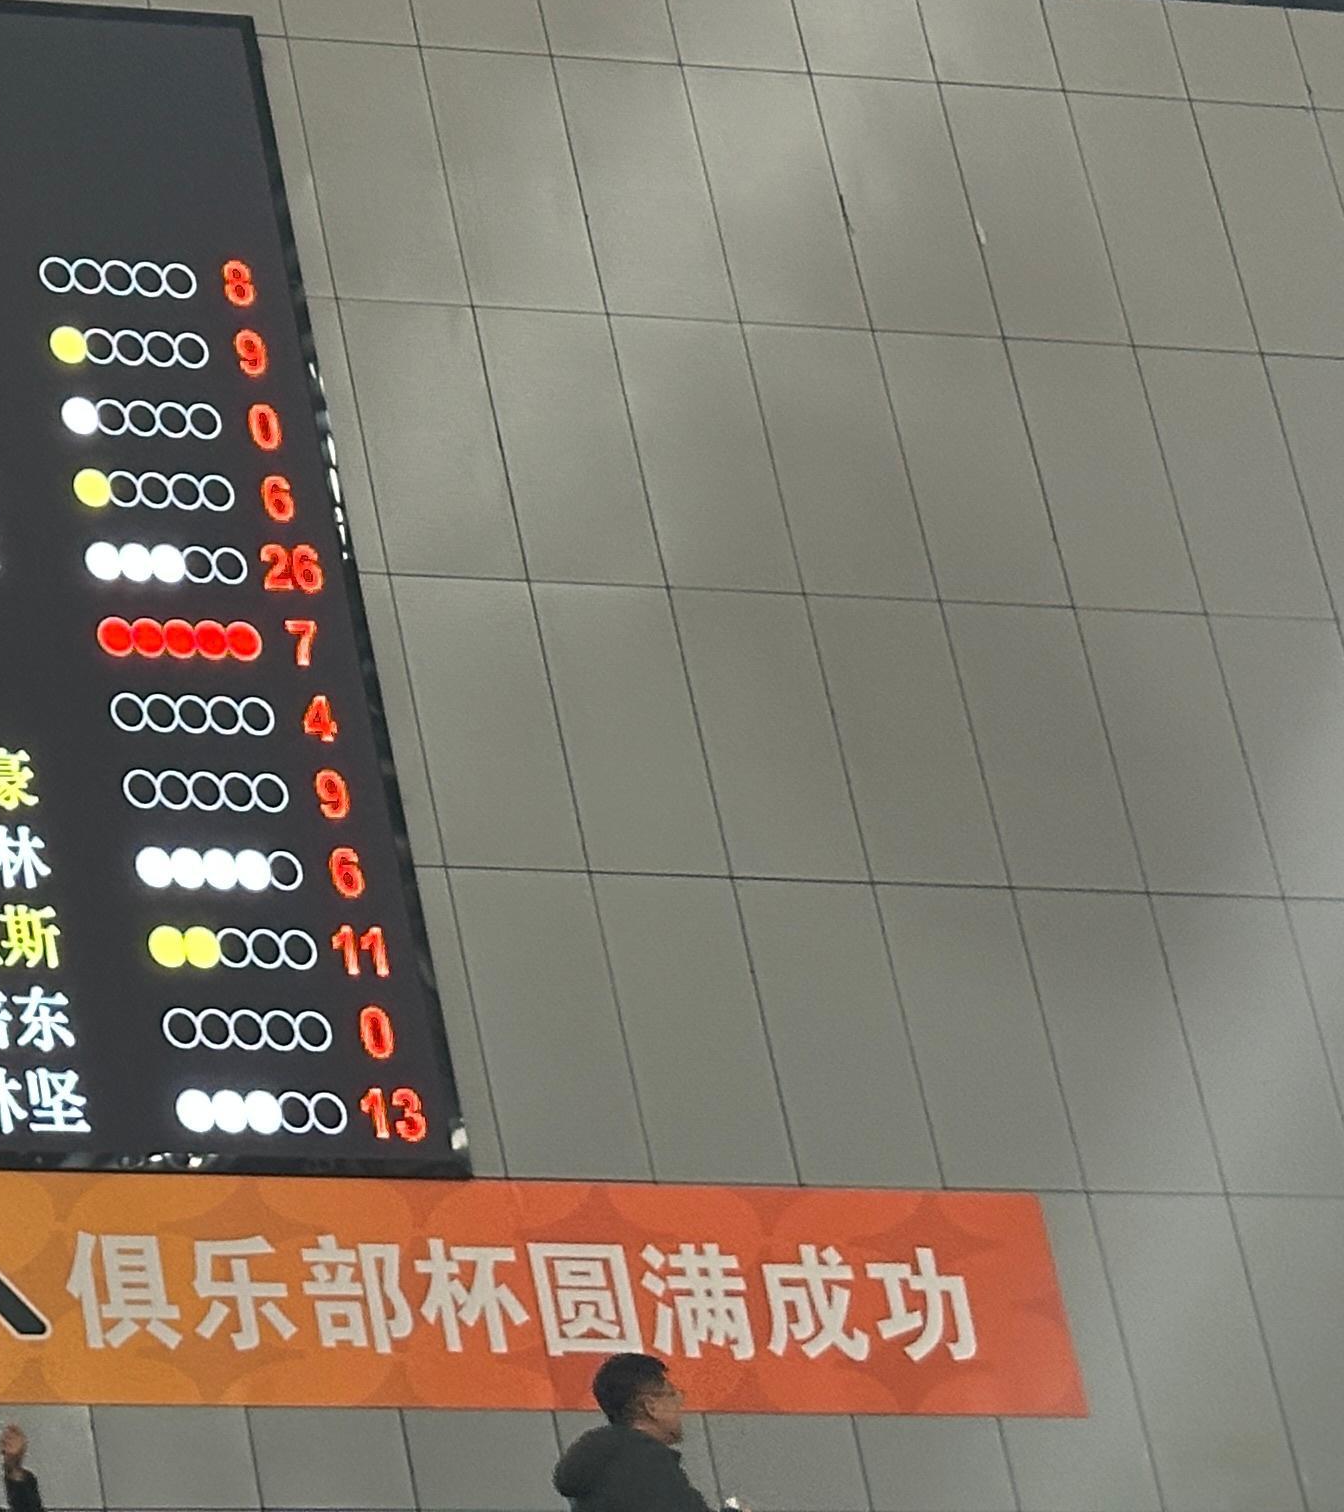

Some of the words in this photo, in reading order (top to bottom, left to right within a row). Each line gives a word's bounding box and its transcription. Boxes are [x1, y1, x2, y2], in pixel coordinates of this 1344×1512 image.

[221, 260, 257, 308] 8
[233, 329, 269, 378] 9
[248, 404, 282, 451] 0
[260, 475, 296, 523] 6
[260, 544, 324, 596] 26
[285, 619, 318, 667] 7
[303, 695, 338, 743] 4
[314, 769, 350, 822] 9
[329, 847, 365, 899] 6
[332, 925, 389, 977] 11
[360, 1005, 395, 1059] 0
[360, 1088, 428, 1142] 13
